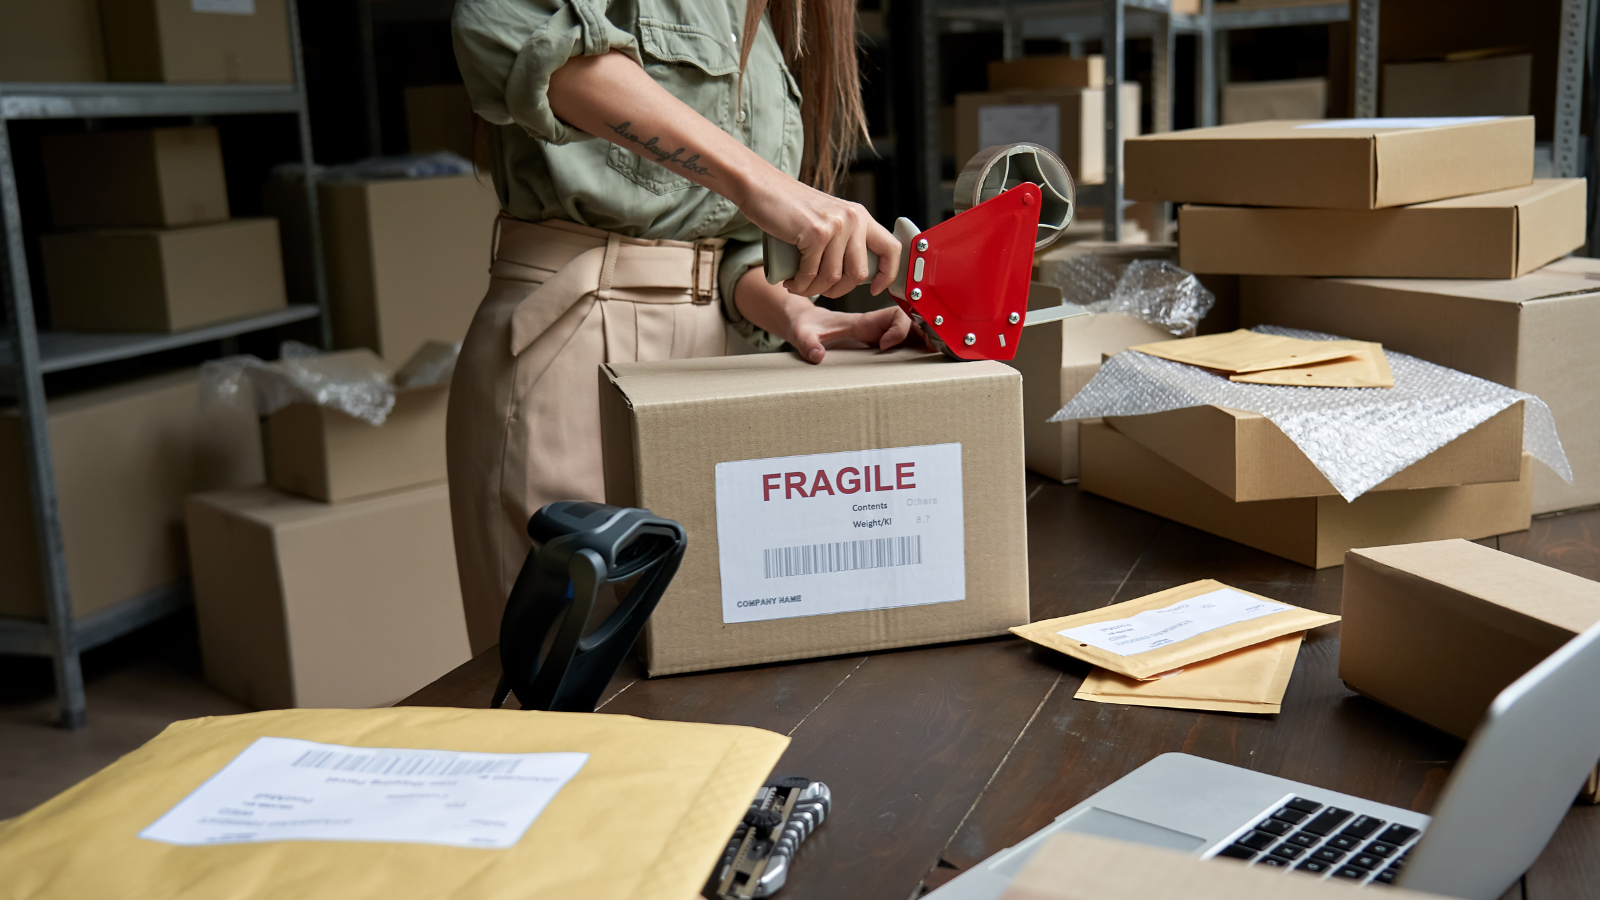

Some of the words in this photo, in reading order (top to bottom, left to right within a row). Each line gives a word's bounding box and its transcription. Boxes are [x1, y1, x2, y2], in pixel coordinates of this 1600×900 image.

[642, 136, 685, 163] laugh
[683, 154, 716, 179] love
[762, 461, 917, 502] FRAGILE
[852, 502, 888, 512] Contents
[906, 497, 938, 507] Others
[736, 597, 777, 608] COMPANY
[778, 594, 802, 604] NAME
